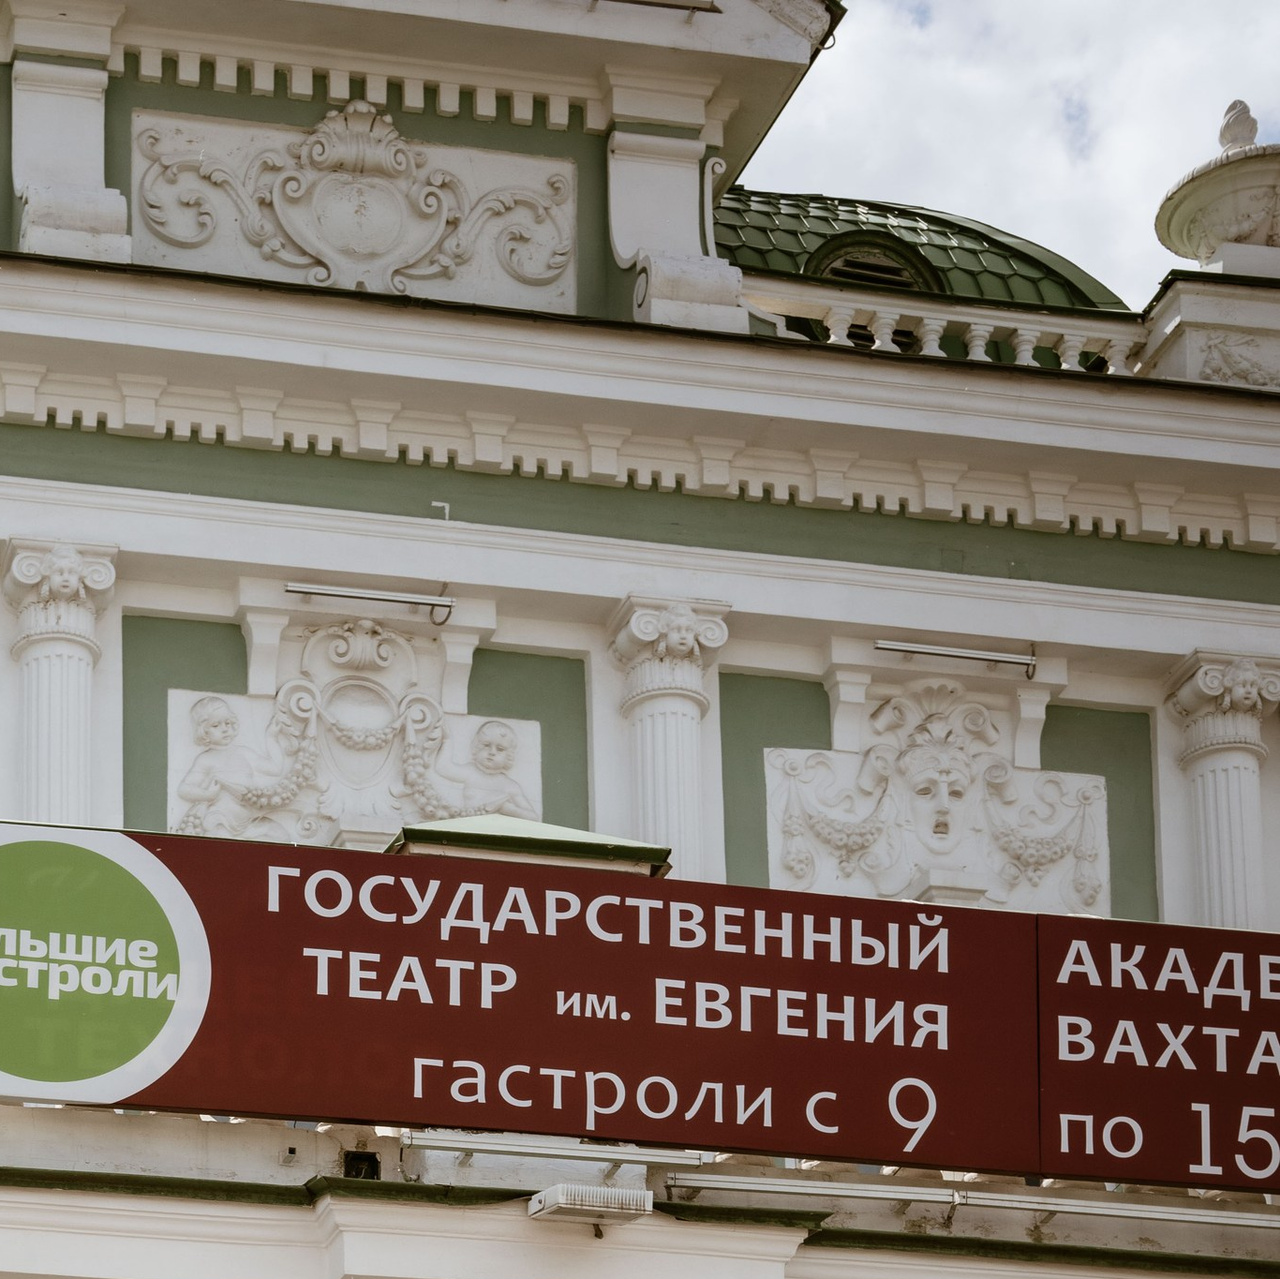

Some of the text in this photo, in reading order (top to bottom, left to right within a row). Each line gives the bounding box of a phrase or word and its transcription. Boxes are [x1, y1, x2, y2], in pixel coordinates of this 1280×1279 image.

[267, 865, 949, 974] ГОСУДАРСТВЕННЫЙ
[302, 947, 949, 1051] ТЕАТР им. ЕВГЕНИЯ
[1056, 939, 1280, 1012] АКАДЕ
[1057, 1015, 1280, 1076] ВАХТА
[412, 1057, 938, 1153] гастроли с 9
[1059, 1102, 1280, 1180] по 15
